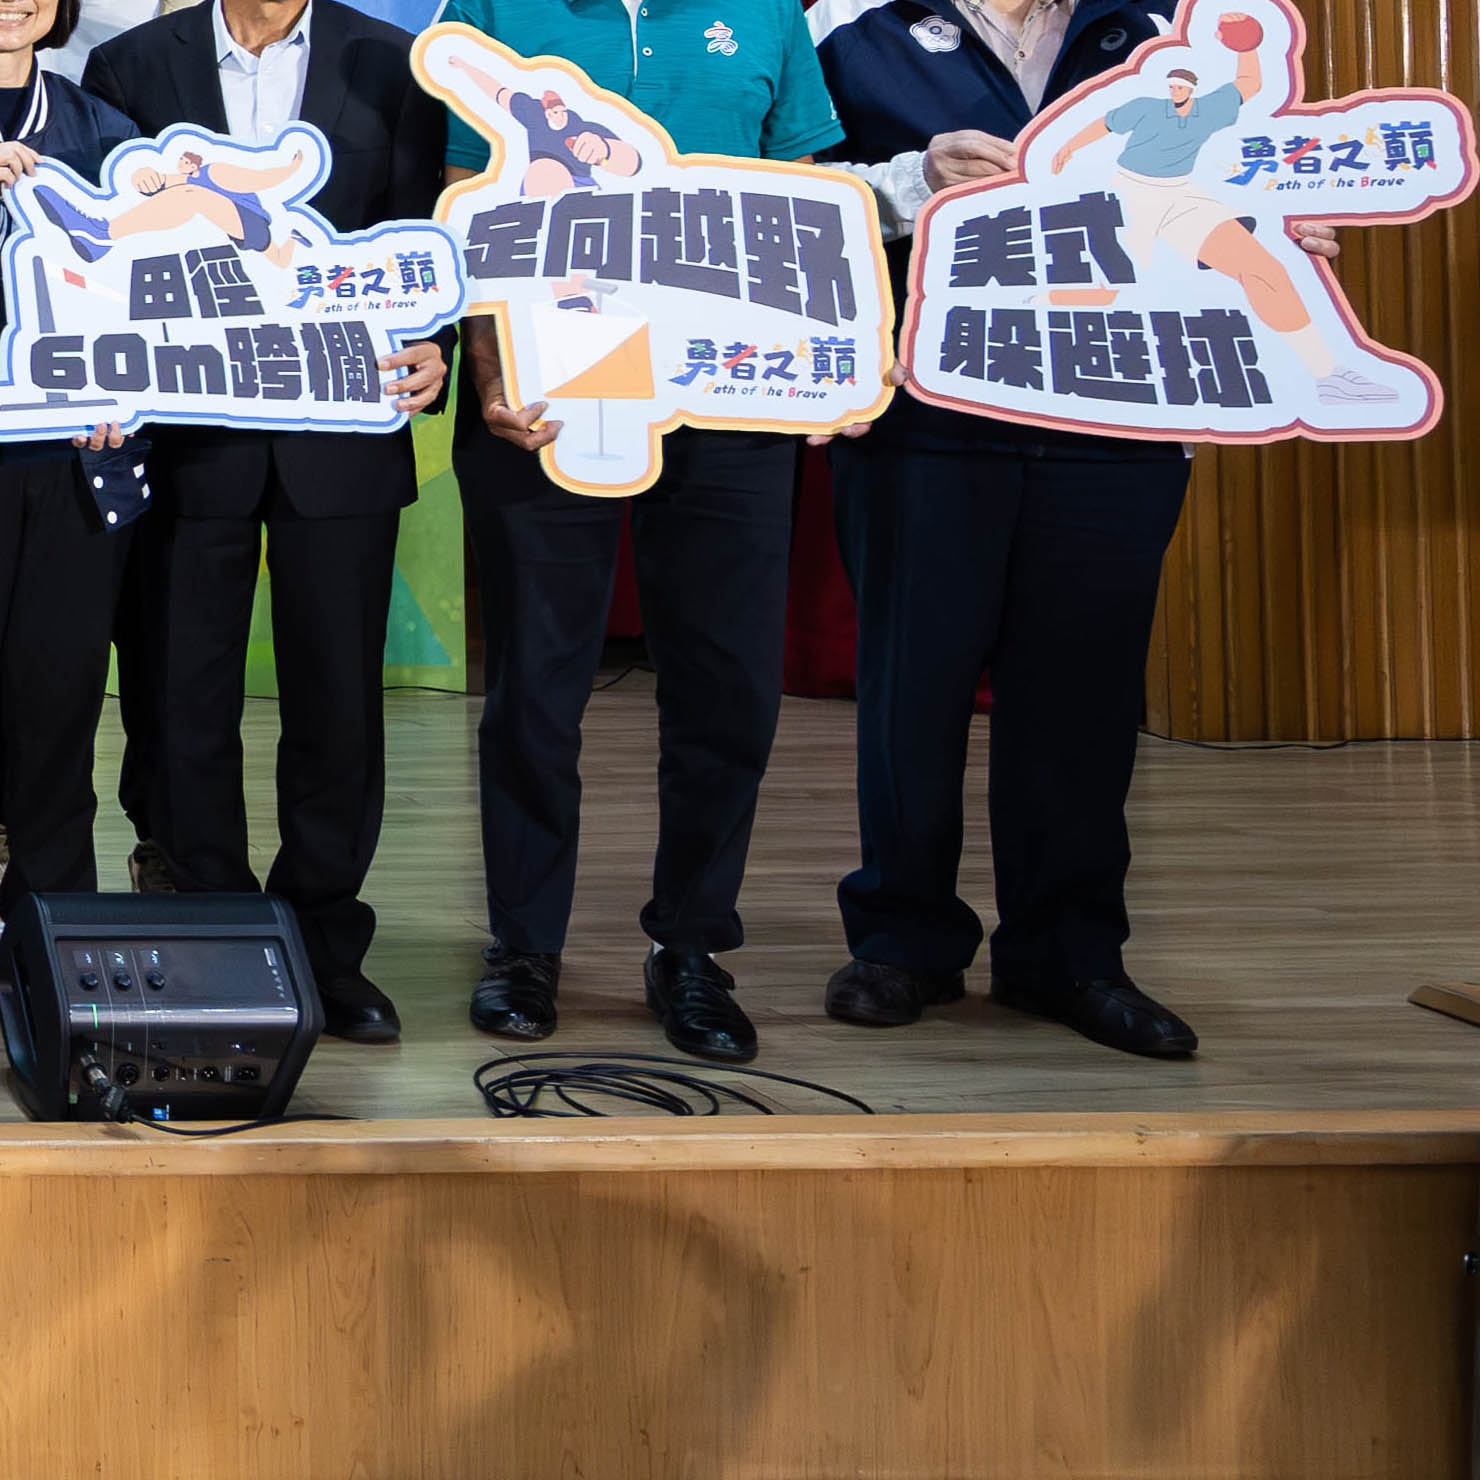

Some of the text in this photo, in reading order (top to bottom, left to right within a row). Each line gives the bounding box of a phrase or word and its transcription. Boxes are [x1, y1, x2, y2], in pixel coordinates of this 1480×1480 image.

[1224, 121, 1437, 186] 勇者之巔
[1307, 176, 1325, 189] of
[1360, 175, 1406, 187] Brave
[464, 187, 857, 328] 定向越野
[948, 191, 1137, 288] 美式
[129, 244, 266, 321] 田徑
[285, 251, 439, 309] 勇者之巔
[347, 302, 360, 311] of
[385, 299, 417, 309] Brave
[668, 336, 856, 387] 勇者之巔
[939, 305, 1274, 409] 躲避球
[741, 385, 758, 396] of
[788, 387, 827, 399] Brave
